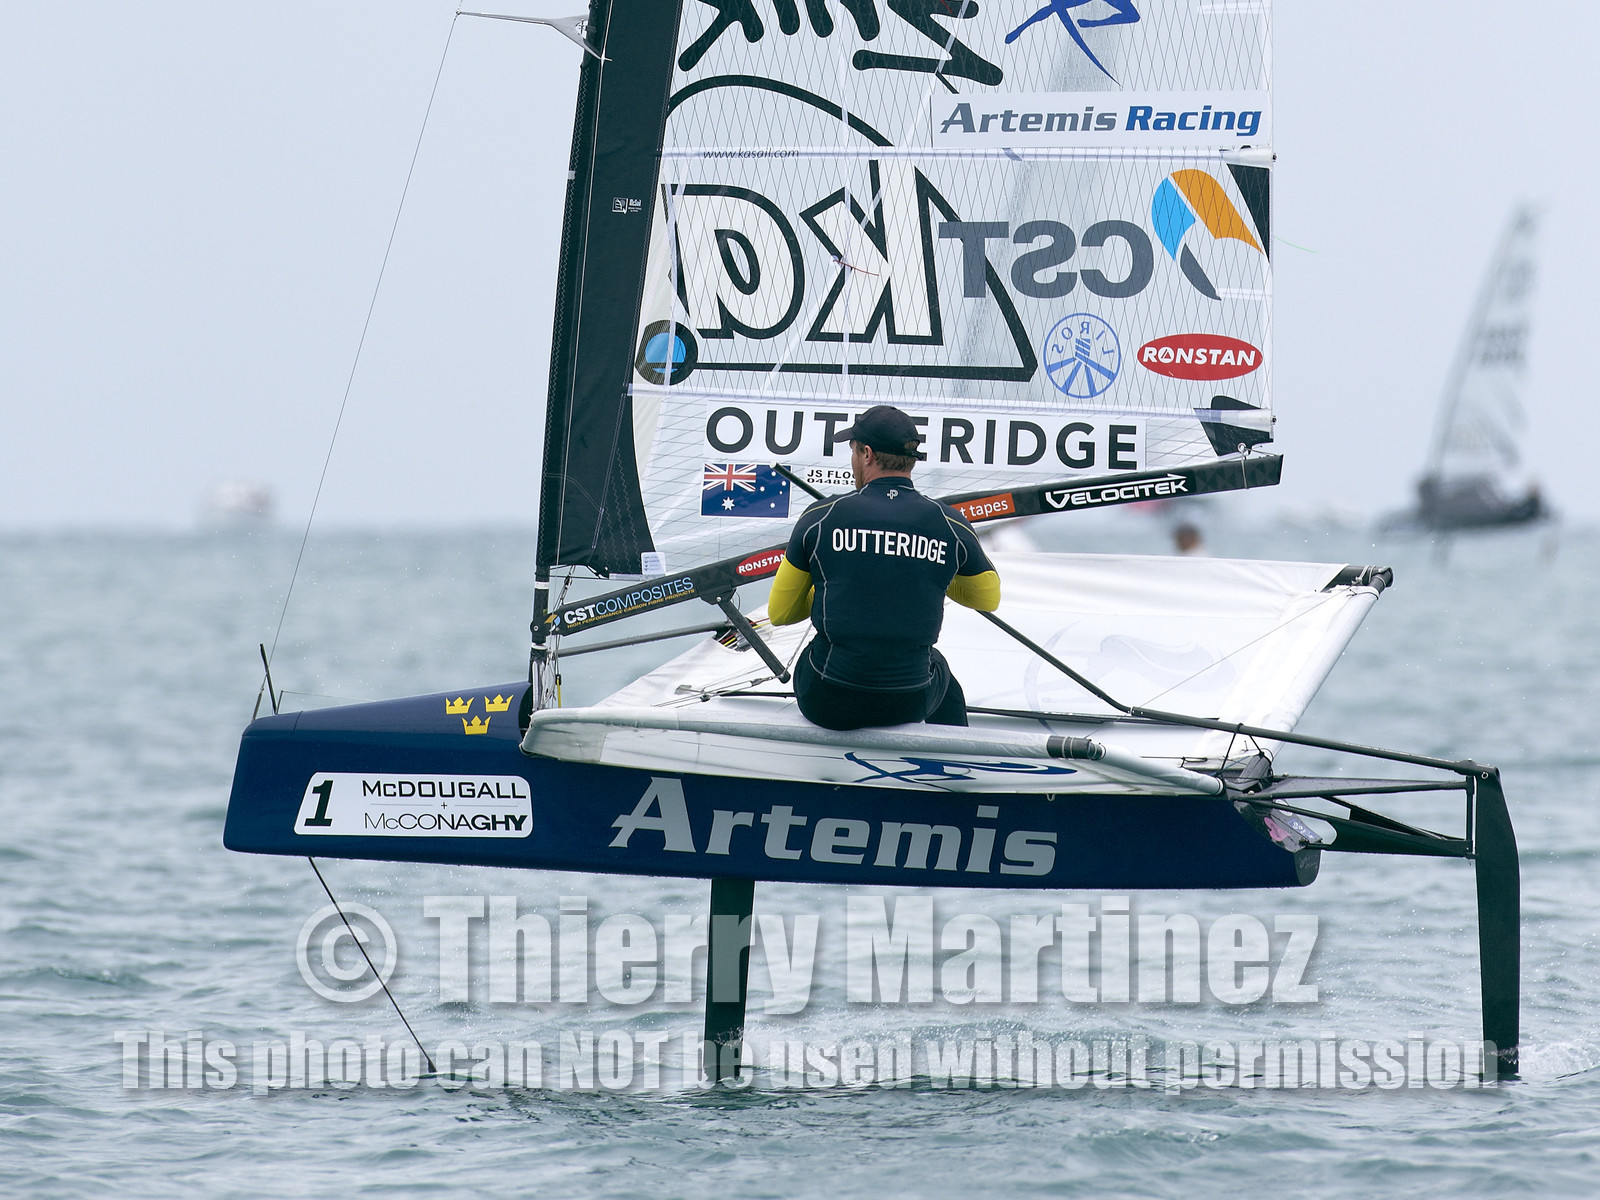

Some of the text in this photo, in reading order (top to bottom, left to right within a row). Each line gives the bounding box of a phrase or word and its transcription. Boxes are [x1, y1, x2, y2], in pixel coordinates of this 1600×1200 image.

[940, 102, 1262, 137] Artemis Racing
[703, 147, 799, 159] www.kasail.com
[1143, 346, 1256, 367] RONSTAN
[706, 406, 1137, 470] OUTERIDGE
[807, 469, 823, 478] JS
[969, 500, 1008, 518] tapes
[1046, 476, 1188, 509] VELOCITEK
[832, 528, 947, 565] OUTTERIDGE
[582, 609, 623, 626] PERFORMANCE
[623, 602, 647, 614] CARBON
[664, 588, 695, 602] PRODUCTS
[304, 779, 334, 826] 1
[362, 780, 527, 799] McDOUGALL
[364, 813, 528, 831] McCONAGHY
[608, 776, 1057, 876] Artemis
